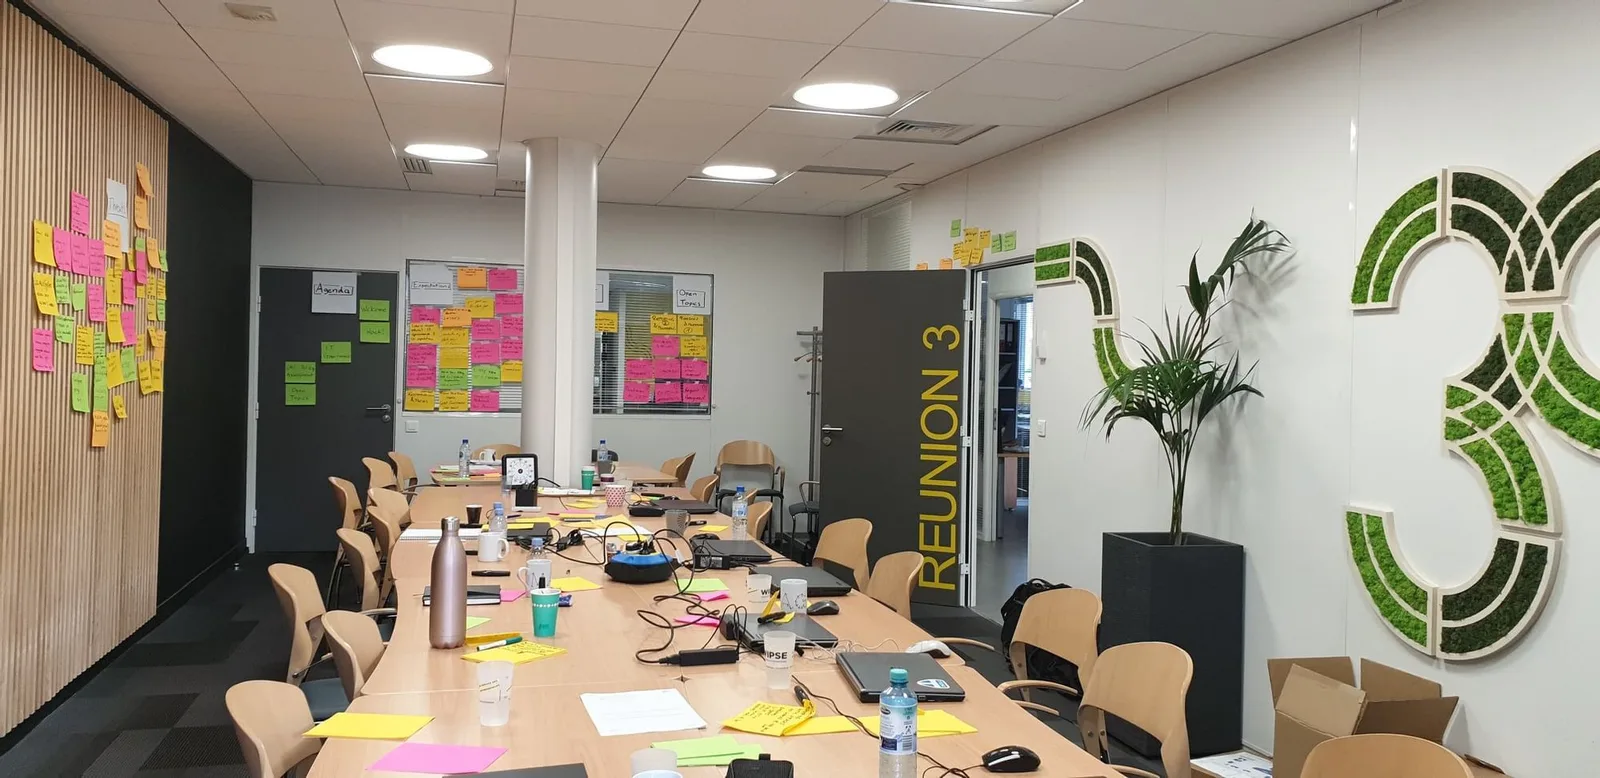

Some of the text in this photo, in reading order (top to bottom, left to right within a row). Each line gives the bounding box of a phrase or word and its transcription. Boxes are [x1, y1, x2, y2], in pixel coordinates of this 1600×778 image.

[316, 282, 350, 295] Agenda
[680, 299, 700, 307] Topics
[918, 324, 961, 590] REUNION 3
